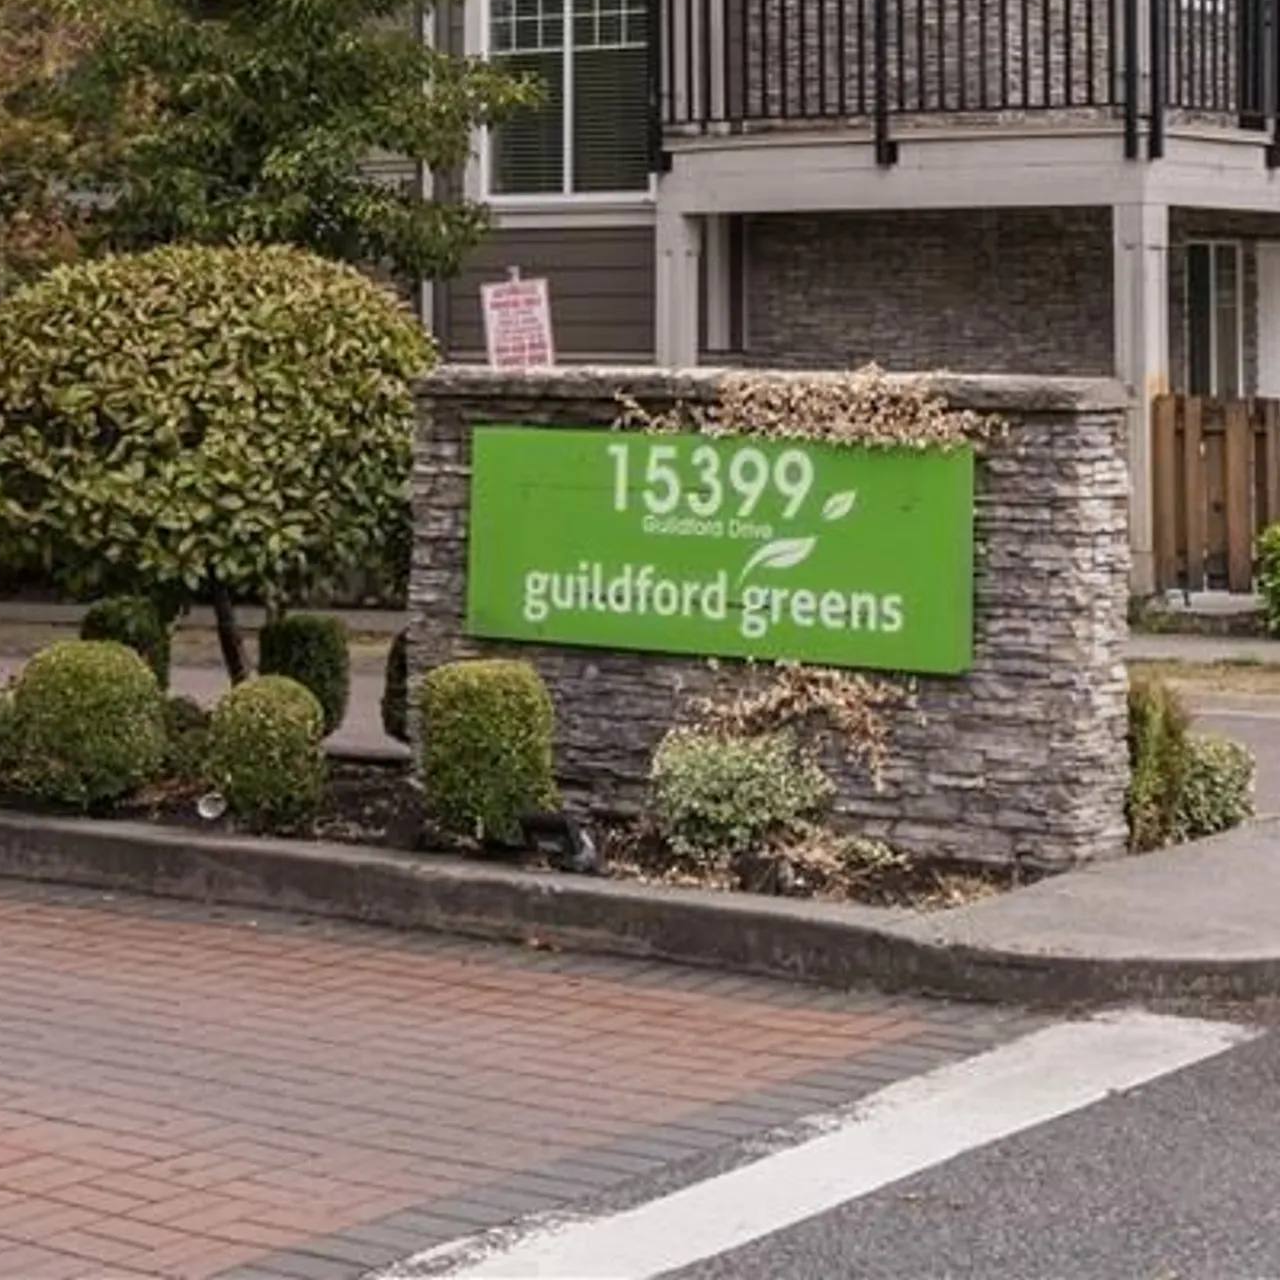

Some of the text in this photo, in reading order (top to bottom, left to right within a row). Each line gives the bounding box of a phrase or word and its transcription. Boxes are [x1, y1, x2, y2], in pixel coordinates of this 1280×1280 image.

[607, 443, 815, 518] 15399
[643, 515, 774, 539] Guildford Drive
[524, 561, 904, 638] guildford greens
